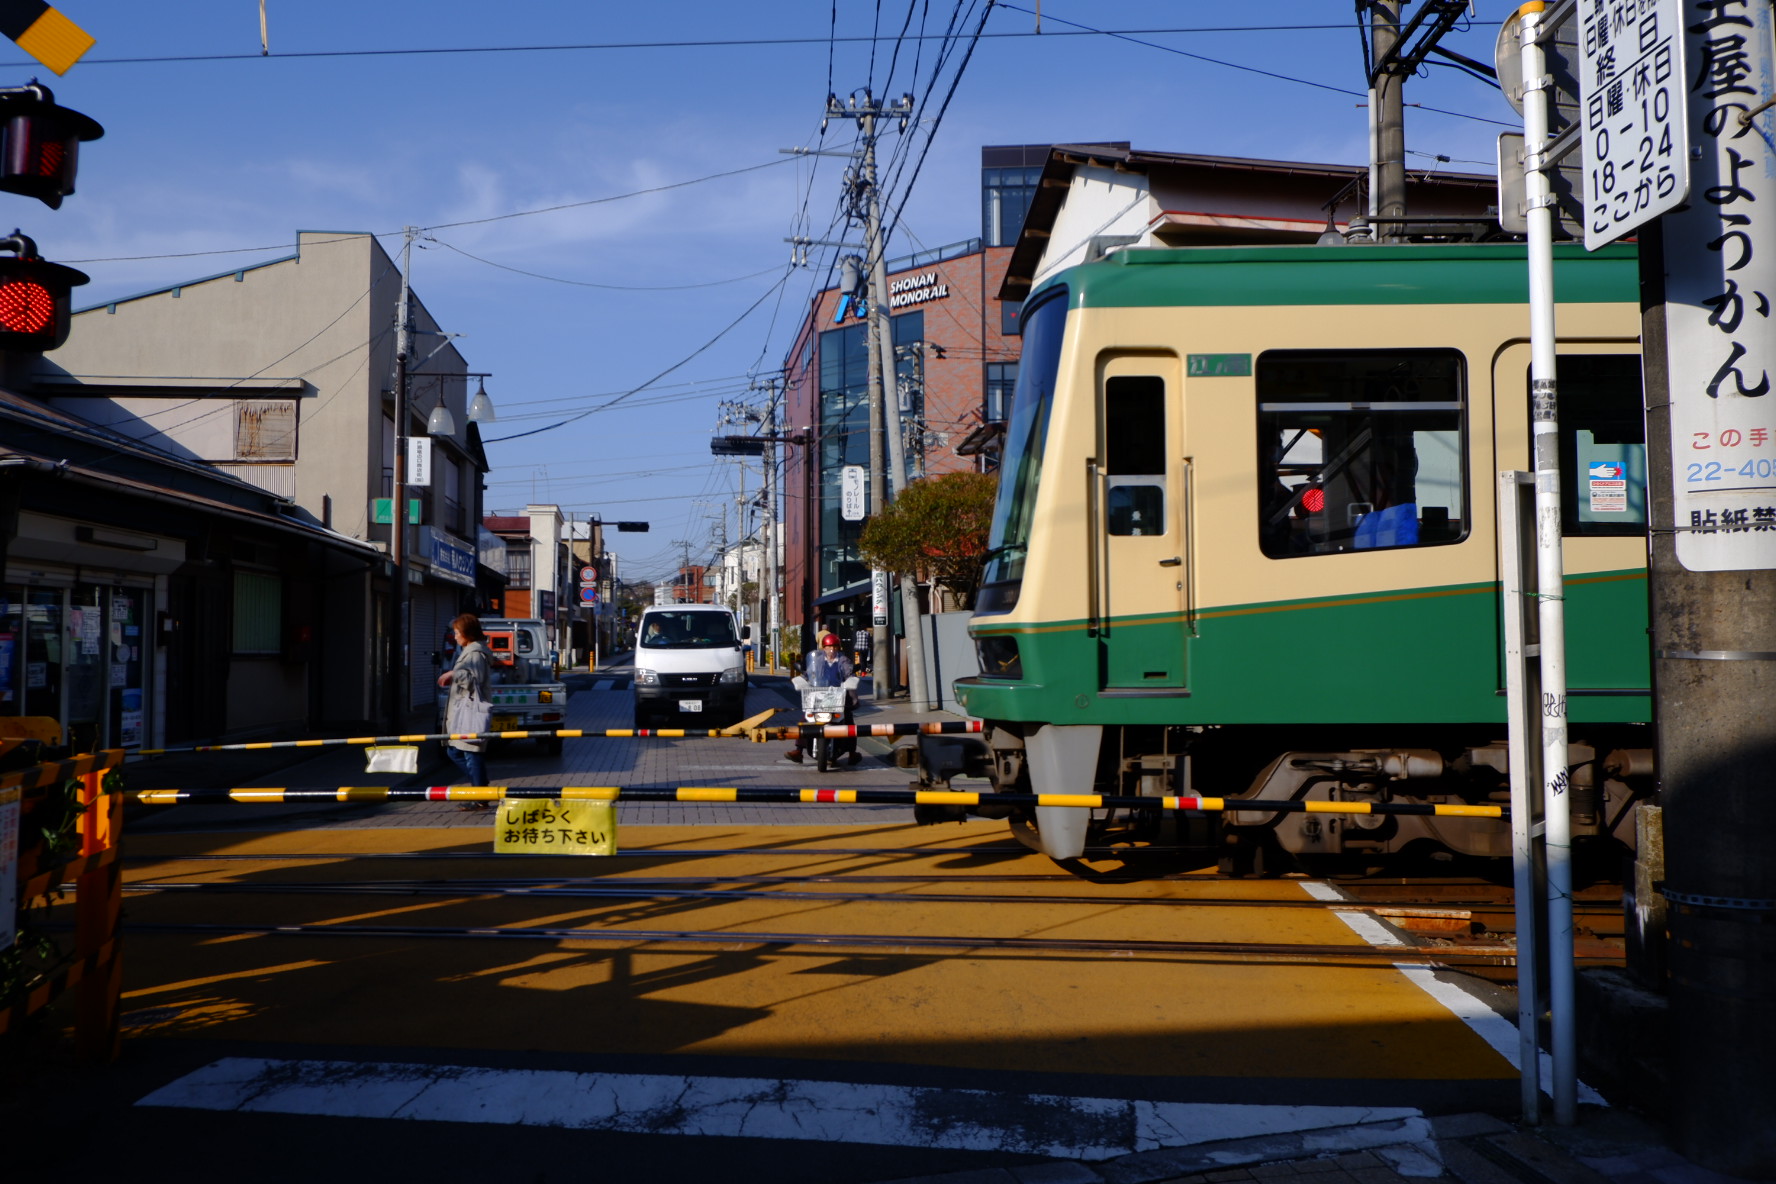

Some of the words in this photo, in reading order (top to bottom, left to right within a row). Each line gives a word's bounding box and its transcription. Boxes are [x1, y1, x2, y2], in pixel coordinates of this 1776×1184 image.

[1593, 165, 1675, 234] ここから
[890, 272, 937, 294] SHONAN
[890, 284, 949, 308] MONORAIL
[1693, 428, 1776, 450] この手
[506, 809, 571, 825] しばらく
[504, 828, 606, 844] お待ち下さい
